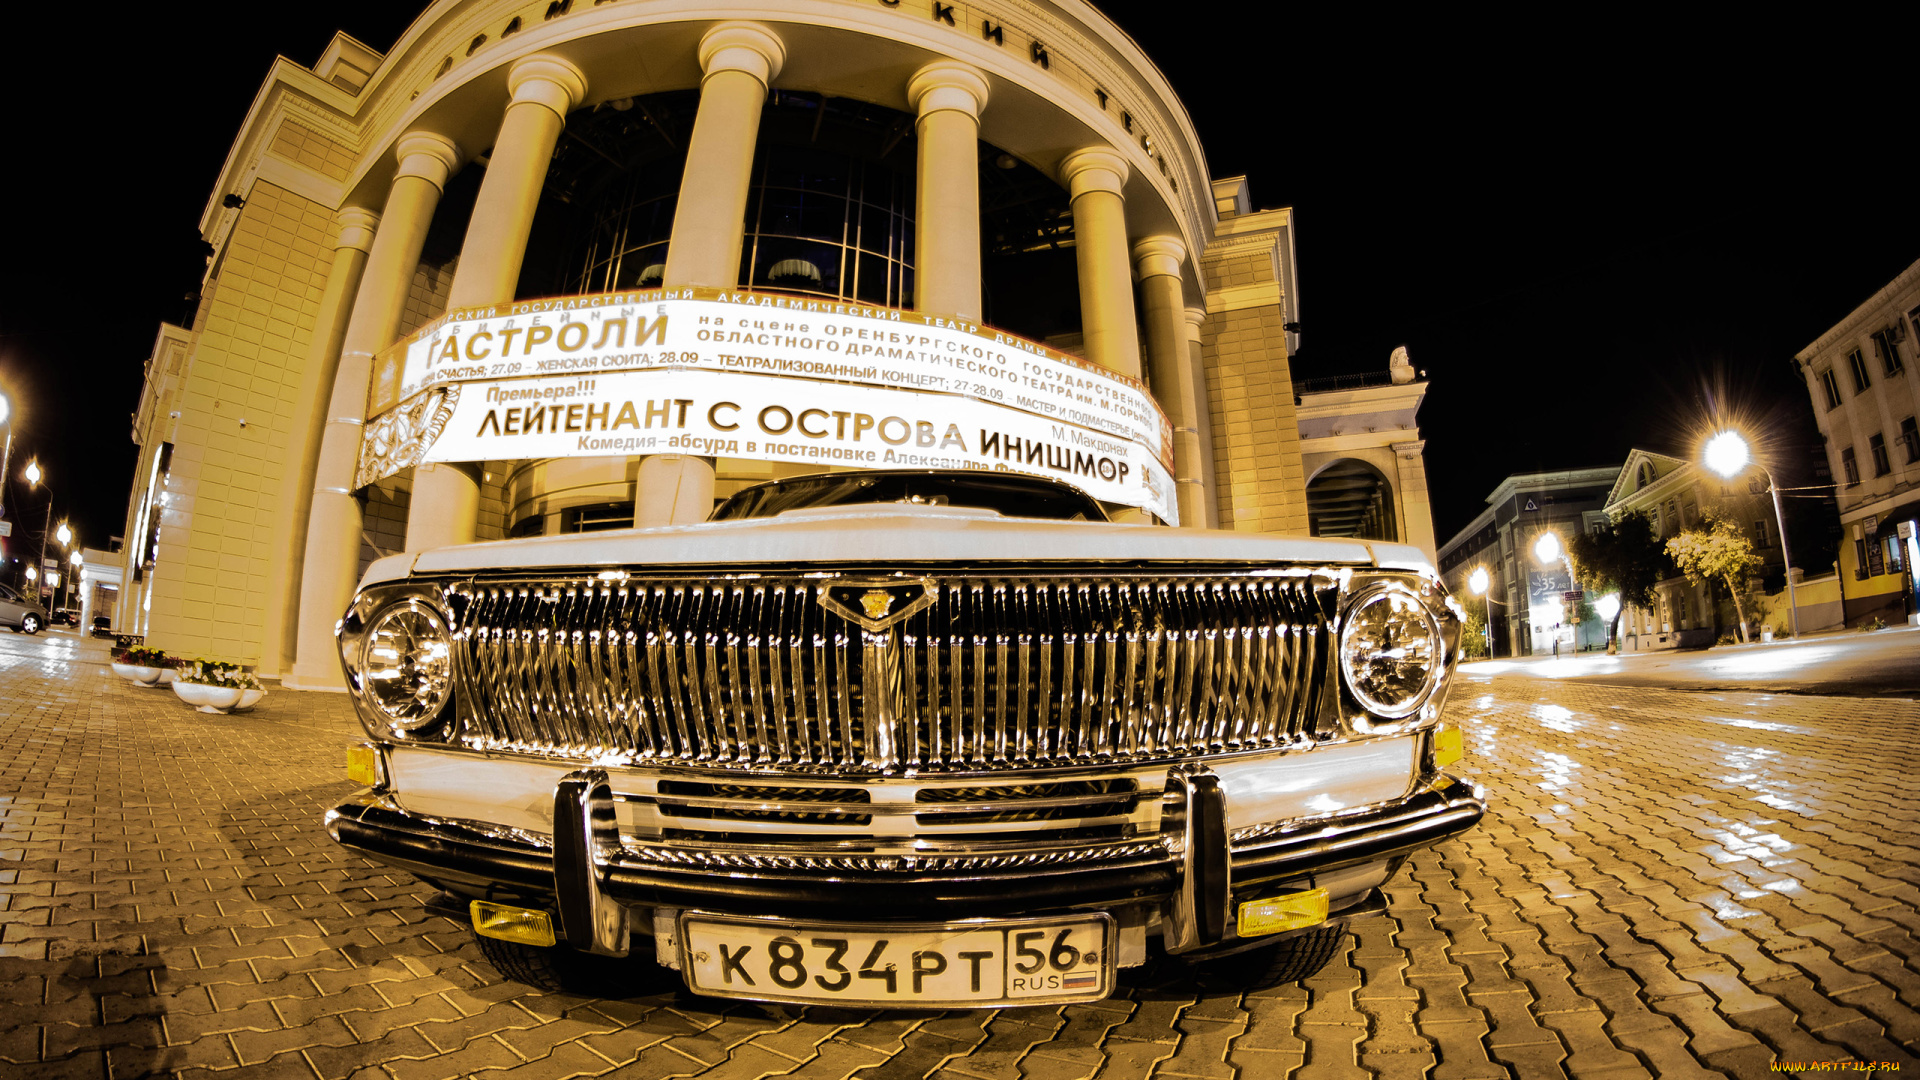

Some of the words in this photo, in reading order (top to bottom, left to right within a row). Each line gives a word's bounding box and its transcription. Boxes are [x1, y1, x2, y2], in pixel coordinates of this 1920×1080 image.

[426, 314, 669, 370] ГАСТРОЛИ
[511, 289, 694, 315] ГОСУДАРСТВЕННЫЙ
[717, 293, 901, 321] АКАДЕМИЧЕСКИЙ
[923, 316, 978, 334] ТЕАТР
[995, 333, 1047, 357] ДРАМЫ
[699, 315, 724, 326] на
[739, 319, 810, 333] сцене
[824, 324, 1007, 365] ОРЕНБУРГСКОГО
[697, 329, 840, 351] ОБЛАСТНОГО
[845, 343, 1018, 383] ДРАМАТИЧЕСКОГО
[1022, 376, 1073, 399] ТЕАТРА
[486, 380, 596, 405] Премьера!!!
[491, 363, 522, 375] 27.09
[536, 356, 598, 371] ЖЕНСКАЯ
[659, 351, 699, 363] 28.09
[717, 354, 877, 379] ТЕАТРАЛИЗОВАННЫЙ
[954, 379, 1004, 400] 27-28.09
[1016, 395, 1057, 413] МАСТЕР
[1068, 409, 1130, 436] ПОДМАСТЕРЬЕ
[476, 398, 694, 437] ЛЕЙТЕНАНТ
[707, 401, 742, 432] С
[757, 405, 968, 453] ОСТРОВА
[980, 428, 1129, 485] ИНИШМОР
[746, 442, 757, 453] в
[765, 442, 877, 462] постановке
[1052, 425, 1069, 442] М.
[1070, 429, 1128, 457] Макдонах
[1013, 928, 1081, 974] 56
[1012, 974, 1060, 992] RUS
